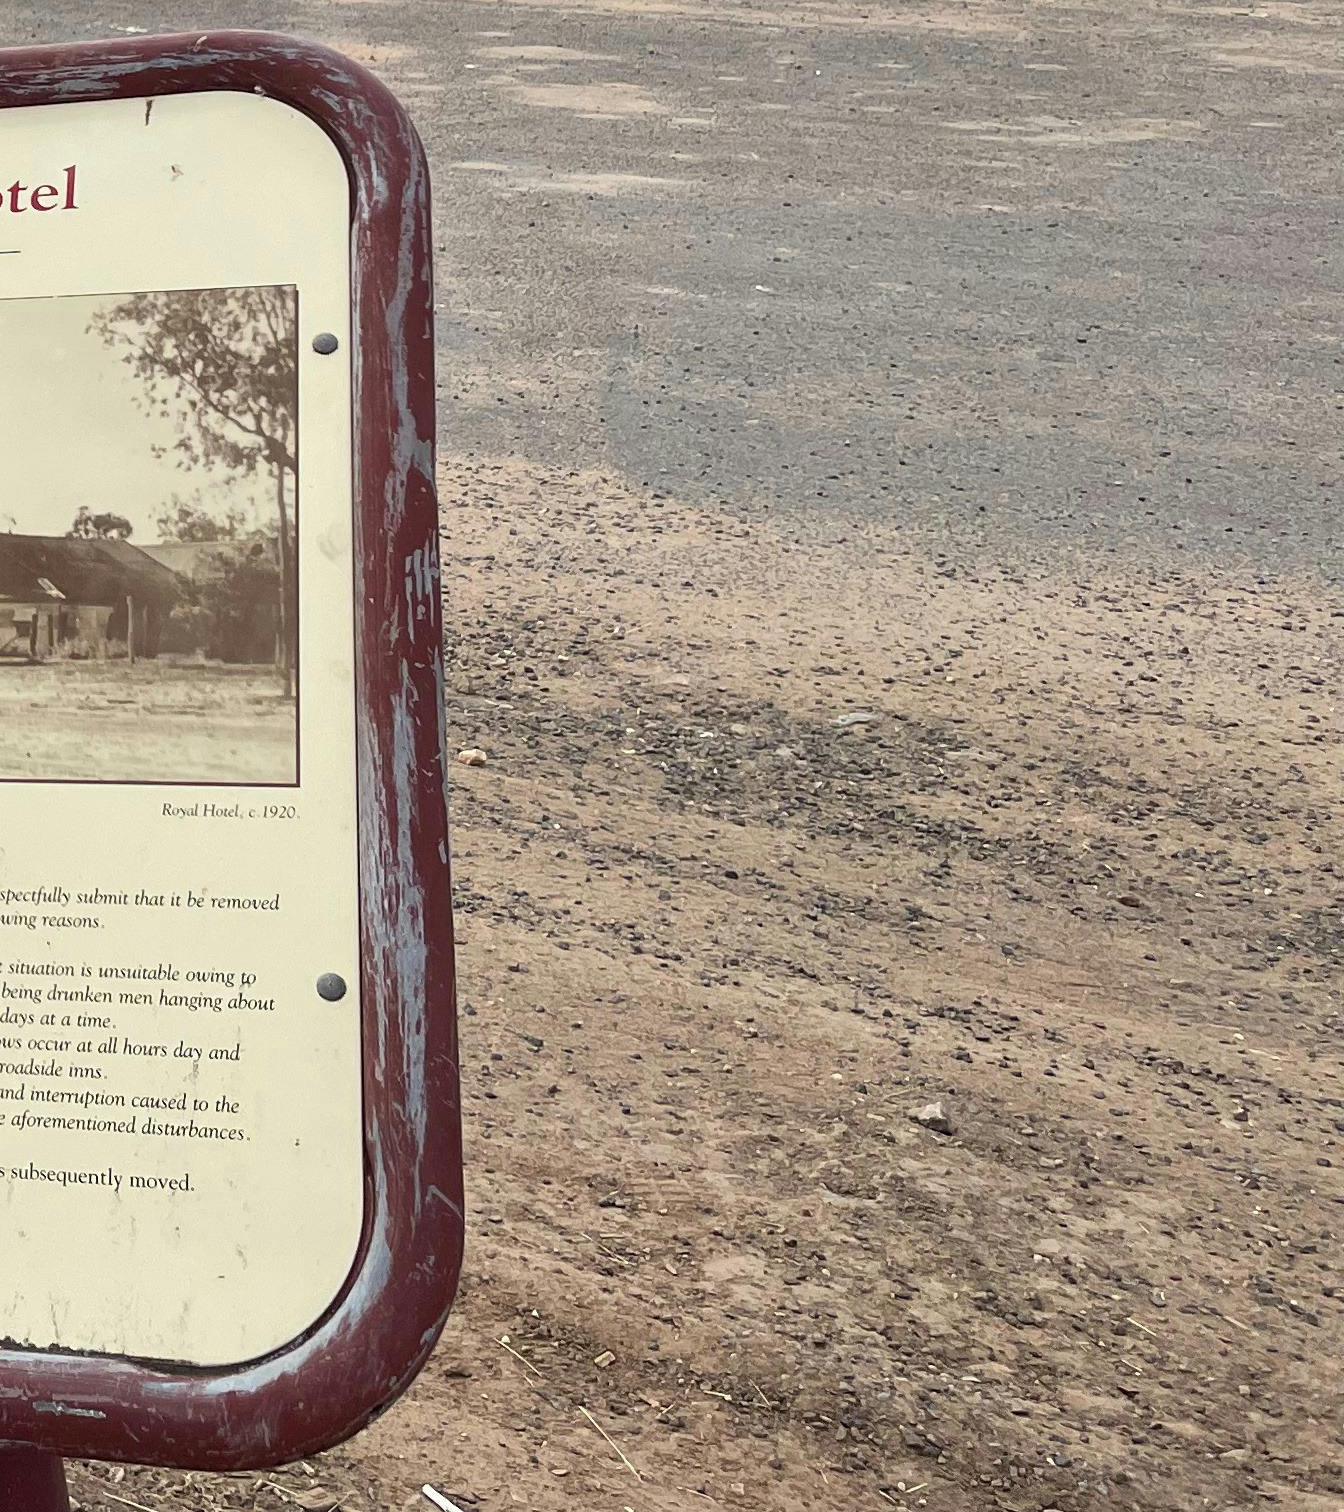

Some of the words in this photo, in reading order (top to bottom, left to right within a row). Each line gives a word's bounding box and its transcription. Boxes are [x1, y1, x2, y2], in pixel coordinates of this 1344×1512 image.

[162, 802, 199, 819] Royal
[203, 803, 244, 819] Hotel,
[263, 805, 300, 819] 1920.
[76, 887, 128, 906] submit
[134, 888, 166, 907] that
[210, 893, 280, 911] removed
[41, 916, 104, 929] reasons.
[7, 958, 75, 977] situation
[98, 963, 180, 982] unsuitable
[185, 968, 236, 988] owing
[1, 981, 43, 1005] being
[46, 983, 113, 1004] drunken
[118, 992, 153, 1006] men
[159, 988, 224, 1013] hanging
[227, 992, 276, 1011] about
[0, 1006, 35, 1029] days
[76, 1011, 116, 1029] time.
[27, 1038, 72, 1052] occur
[97, 1036, 118, 1054] all
[122, 1037, 168, 1058] hours
[173, 1040, 203, 1060] day
[208, 1042, 240, 1061] and
[68, 1062, 108, 1080] inns.
[30, 1085, 126, 1109] interruption
[131, 1092, 187, 1113] caused
[215, 1094, 240, 1114] the
[10, 1108, 138, 1136] aforementioned
[141, 1116, 251, 1142] disturbances.
[10, 1162, 123, 1192] subsequently
[129, 1172, 195, 1196] moved.
